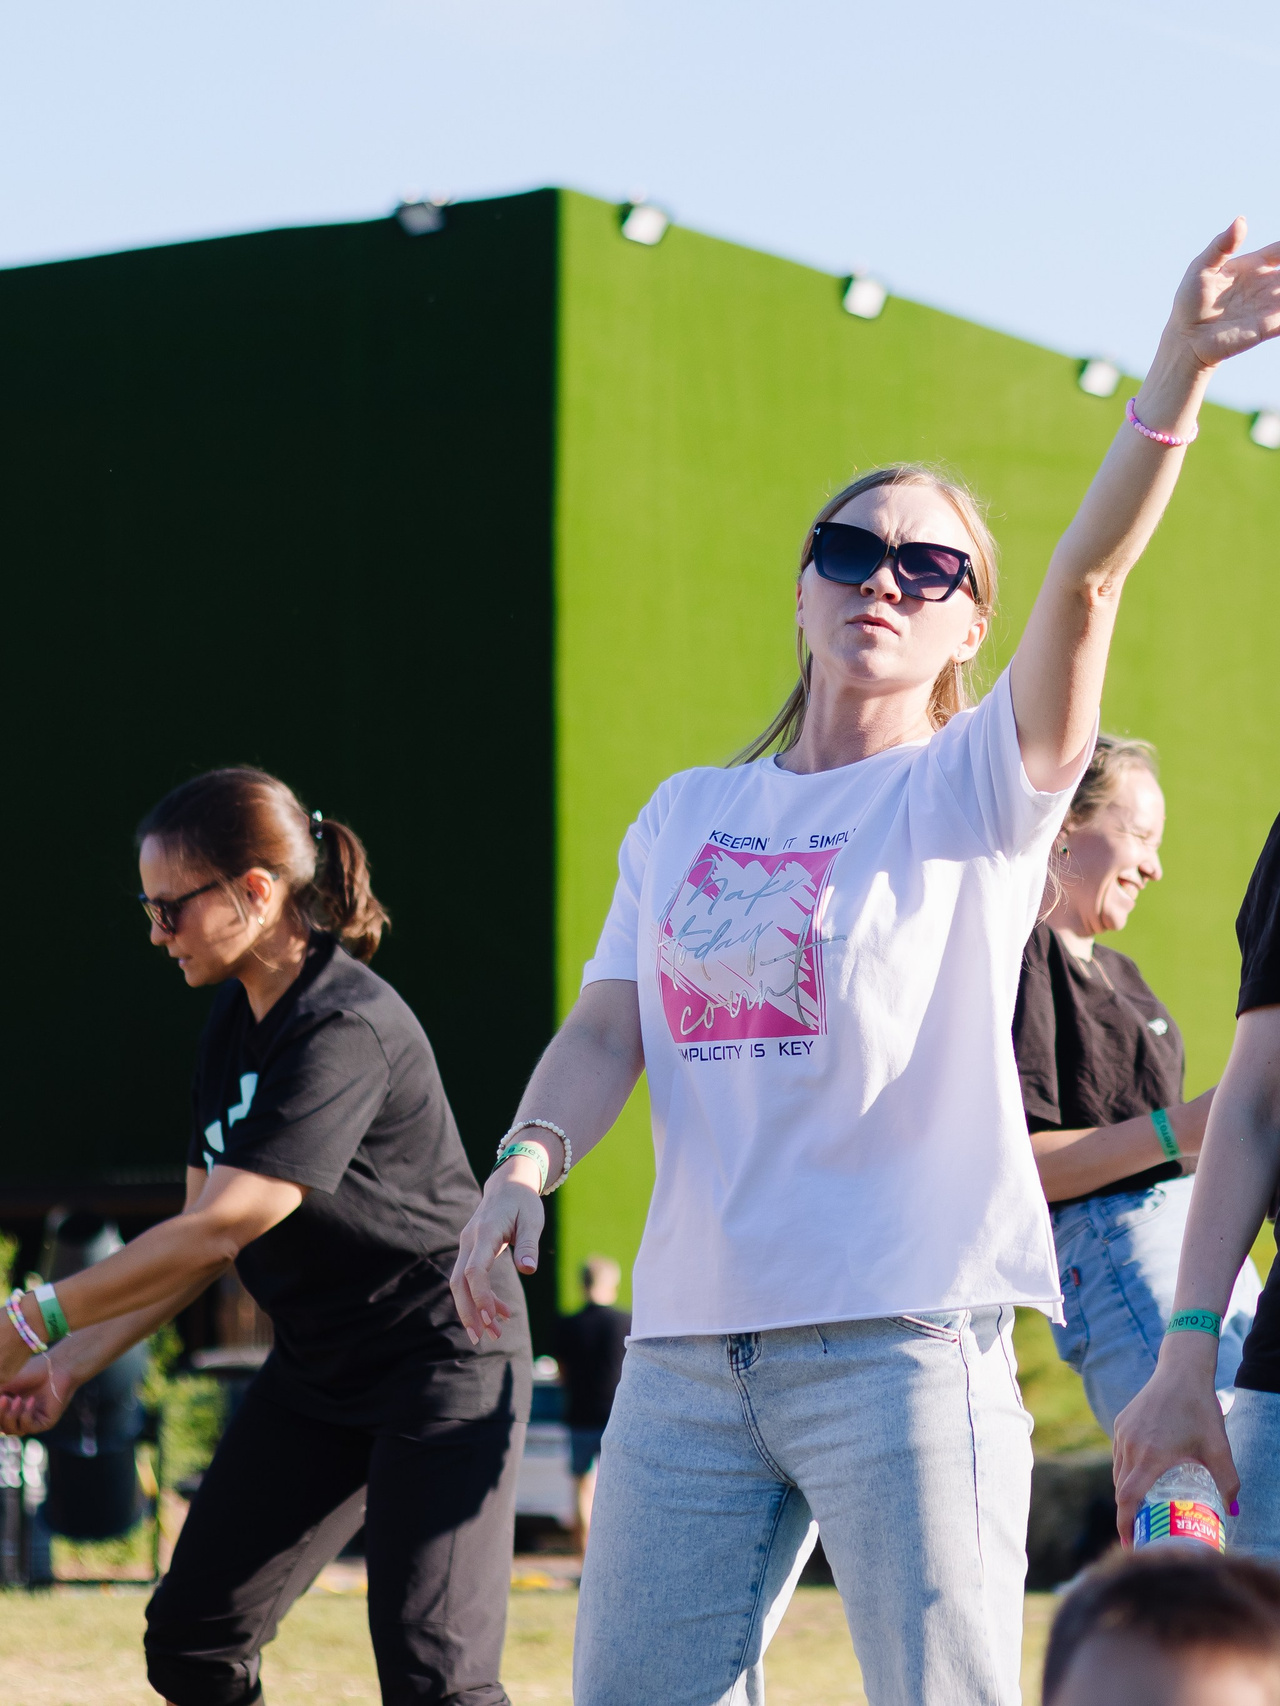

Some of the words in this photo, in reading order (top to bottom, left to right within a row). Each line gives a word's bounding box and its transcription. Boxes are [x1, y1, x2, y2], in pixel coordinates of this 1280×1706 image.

[782, 836, 798, 850] IT
[809, 828, 856, 849] SIMPL
[680, 913, 847, 1036] count
[678, 1044, 742, 1062] MPLICITY
[750, 1043, 766, 1058] IS
[778, 1040, 814, 1056] KEY
[1172, 1315, 1199, 1328] лето
[1175, 1518, 1217, 1541] MEVER
